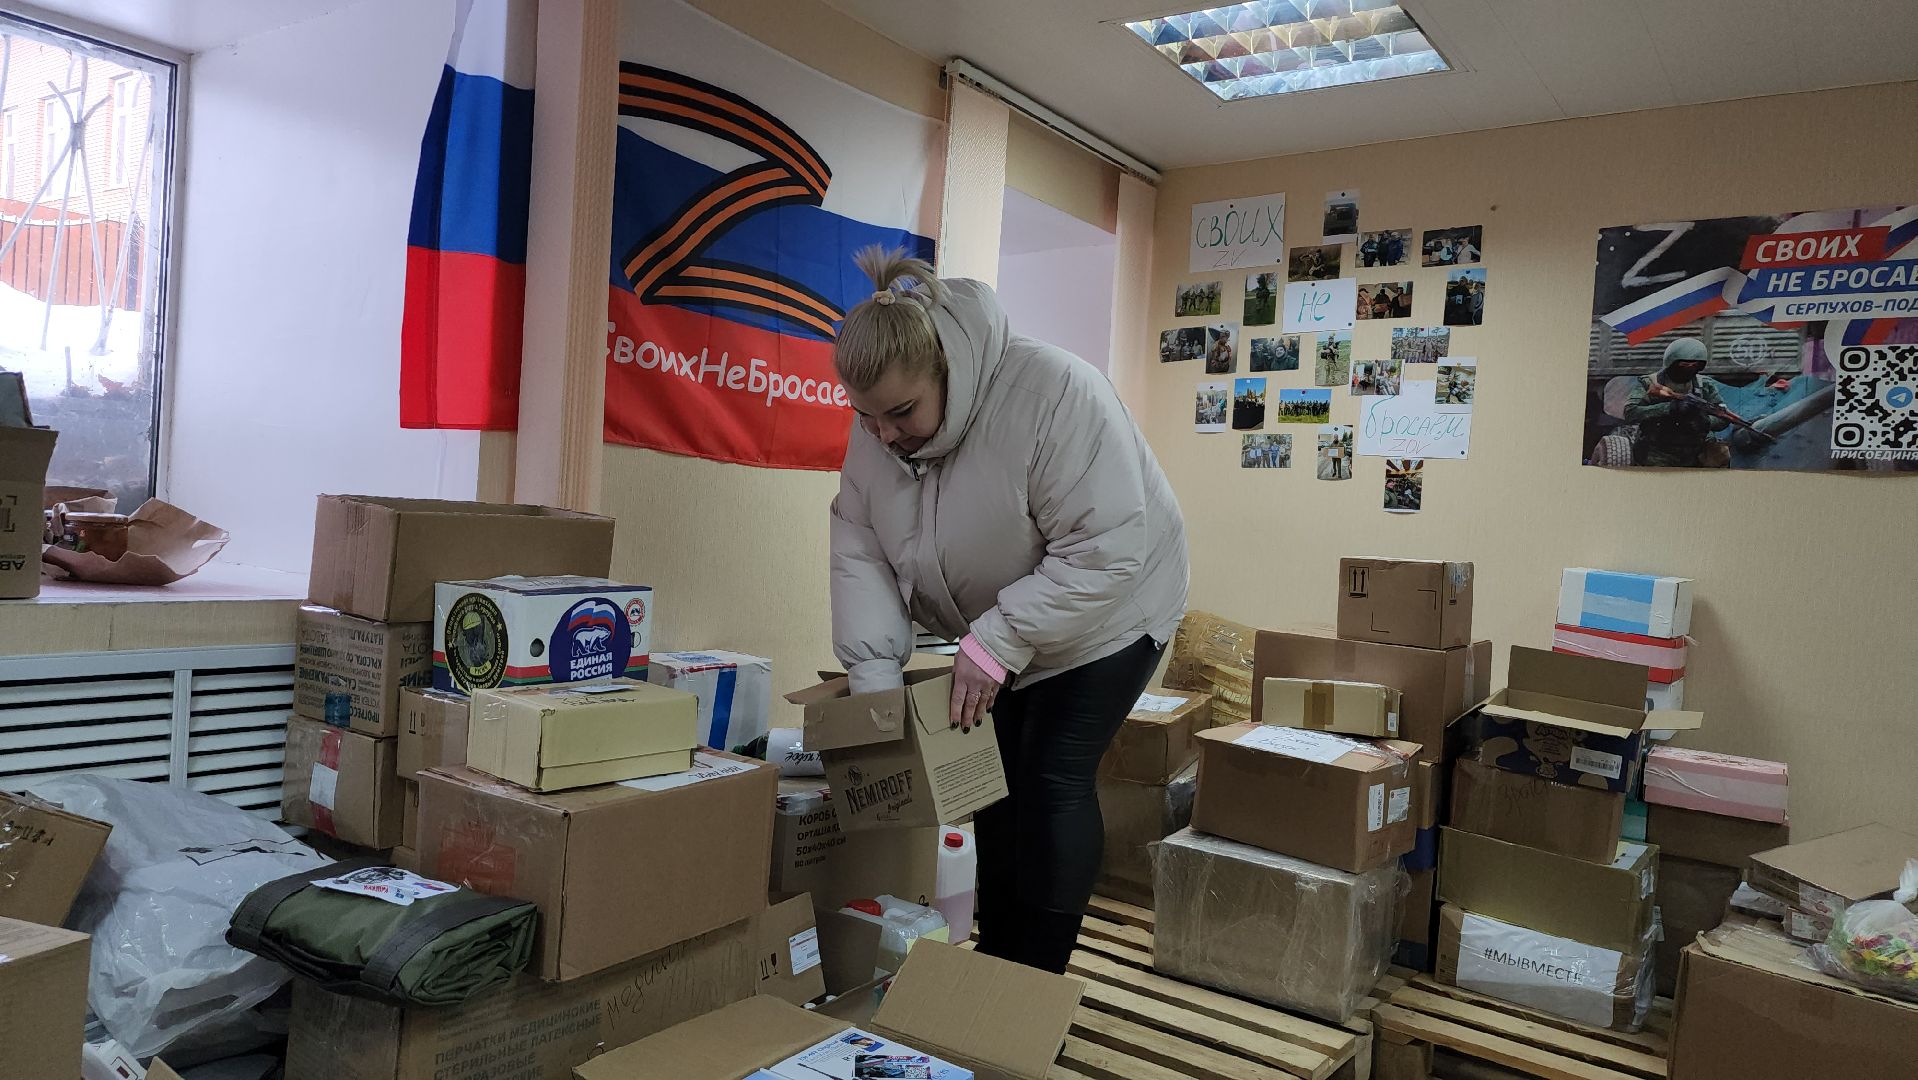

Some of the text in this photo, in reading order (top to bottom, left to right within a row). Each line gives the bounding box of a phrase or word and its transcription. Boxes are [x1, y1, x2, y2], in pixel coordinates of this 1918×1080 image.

[1755, 233, 1864, 264] СВОИХ
[1766, 270, 1806, 293] НЕ
[606, 321, 854, 407] воихНеБросае
[570, 652, 613, 670] ЕДИНАЯ
[570, 663, 613, 680] РОССИЯ
[798, 810, 831, 826] КОРОБ
[434, 1030, 507, 1066] ПЕРЧАТКИ
